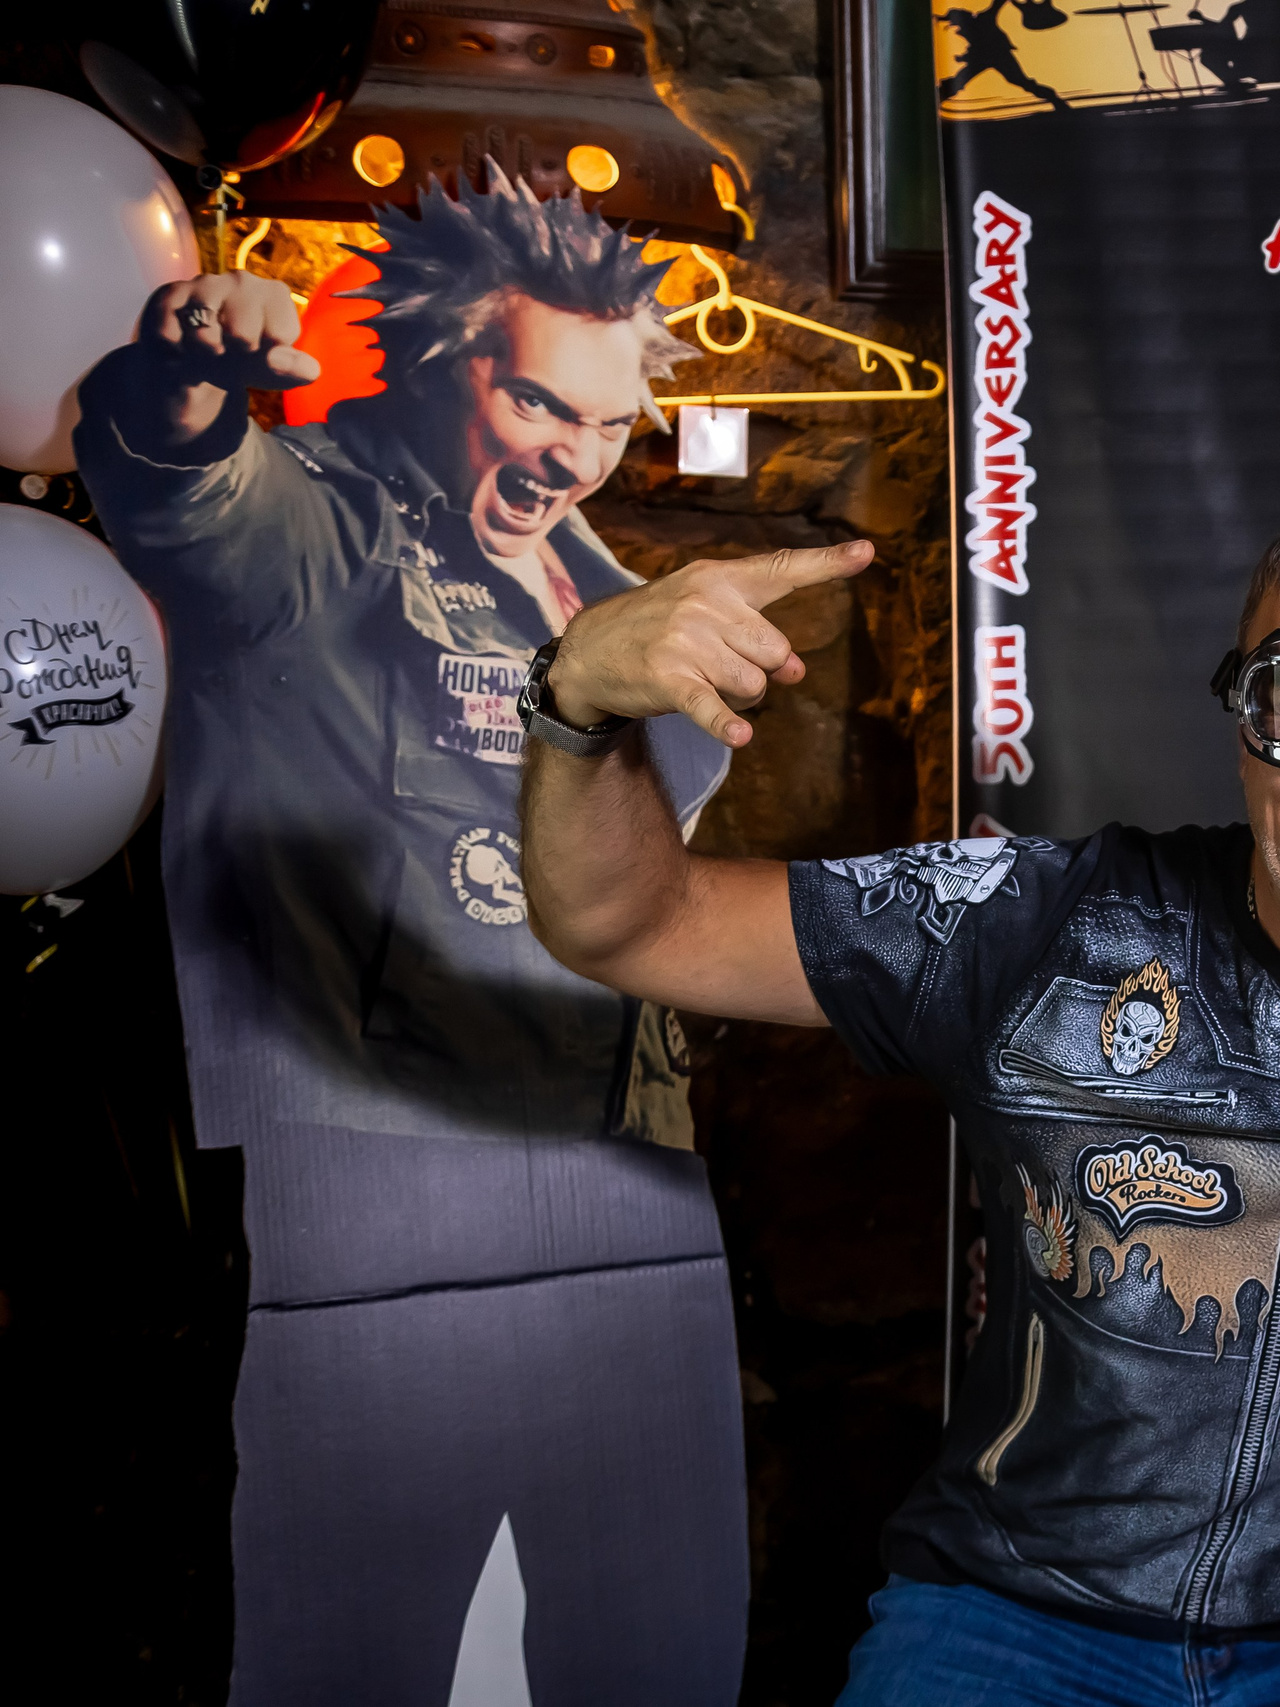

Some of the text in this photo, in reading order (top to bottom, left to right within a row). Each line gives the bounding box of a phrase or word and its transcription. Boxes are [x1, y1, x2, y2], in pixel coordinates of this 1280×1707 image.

[965, 190, 1037, 596] ANNIVERSARY
[1089, 1146, 1221, 1199] Old School
[1119, 1183, 1187, 1205] Rockers
